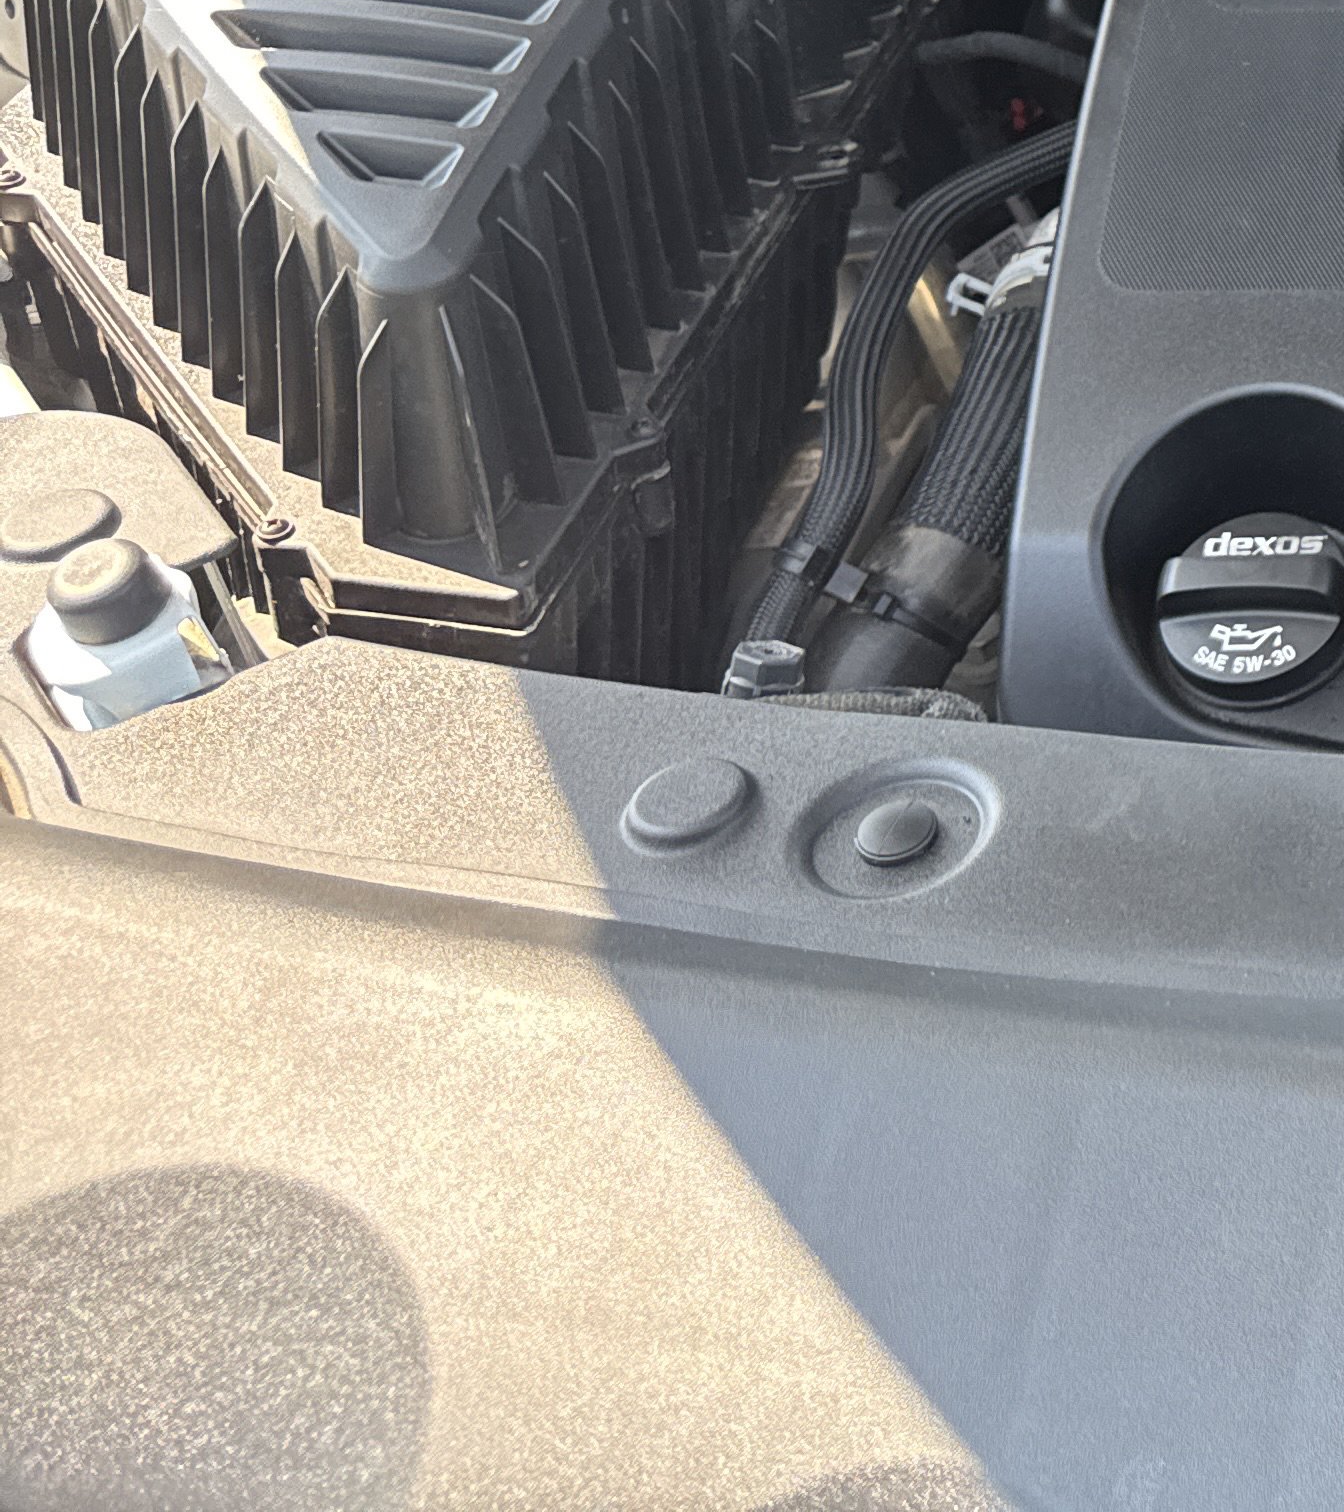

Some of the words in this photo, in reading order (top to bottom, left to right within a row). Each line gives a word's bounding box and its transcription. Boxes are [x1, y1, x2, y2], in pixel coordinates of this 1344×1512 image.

[1202, 531, 1329, 558] dexos
[1192, 645, 1230, 672] SAE
[1232, 644, 1297, 674] 5W-30
